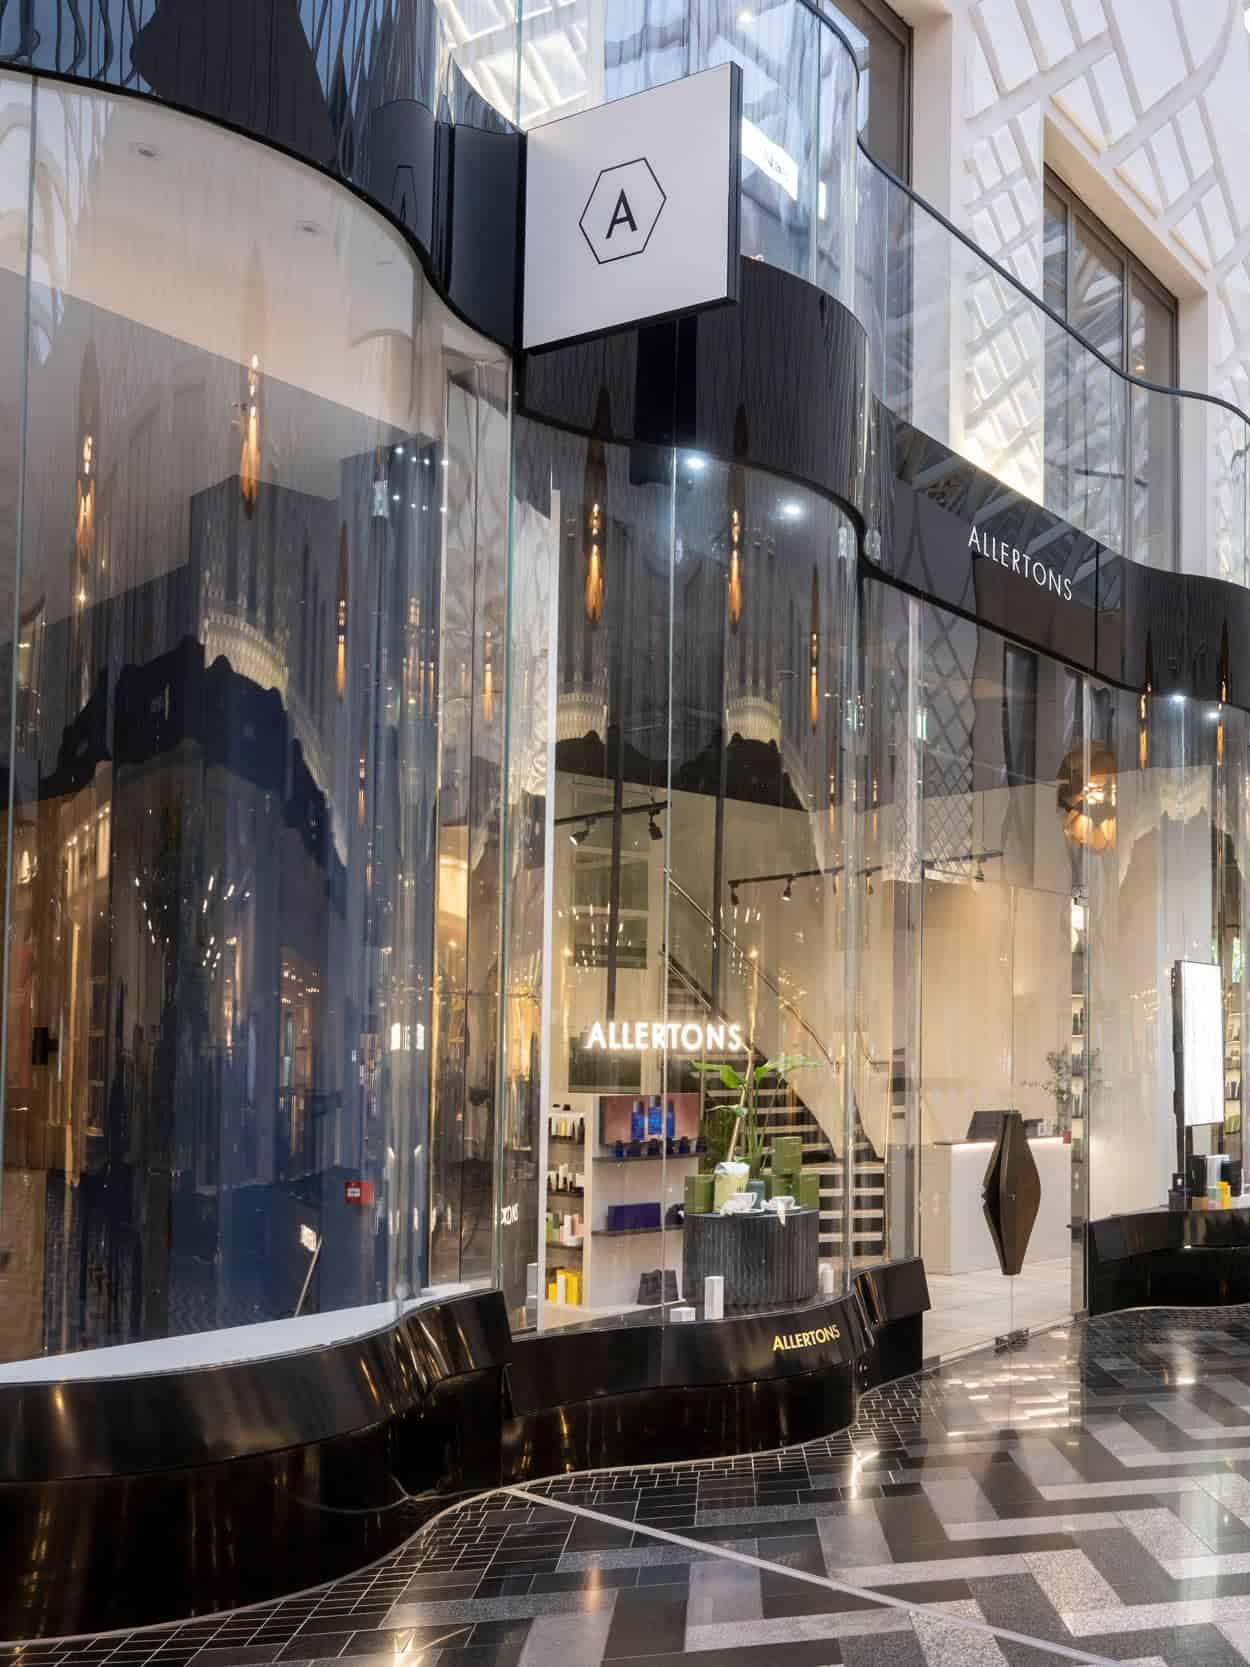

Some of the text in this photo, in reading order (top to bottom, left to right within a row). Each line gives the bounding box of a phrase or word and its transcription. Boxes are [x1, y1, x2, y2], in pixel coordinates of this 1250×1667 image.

[606, 187, 638, 240] A
[967, 524, 1073, 601] ALLERTONS
[585, 1021, 743, 1051] ALLERTONS
[772, 1323, 841, 1351] ALLERTONS
